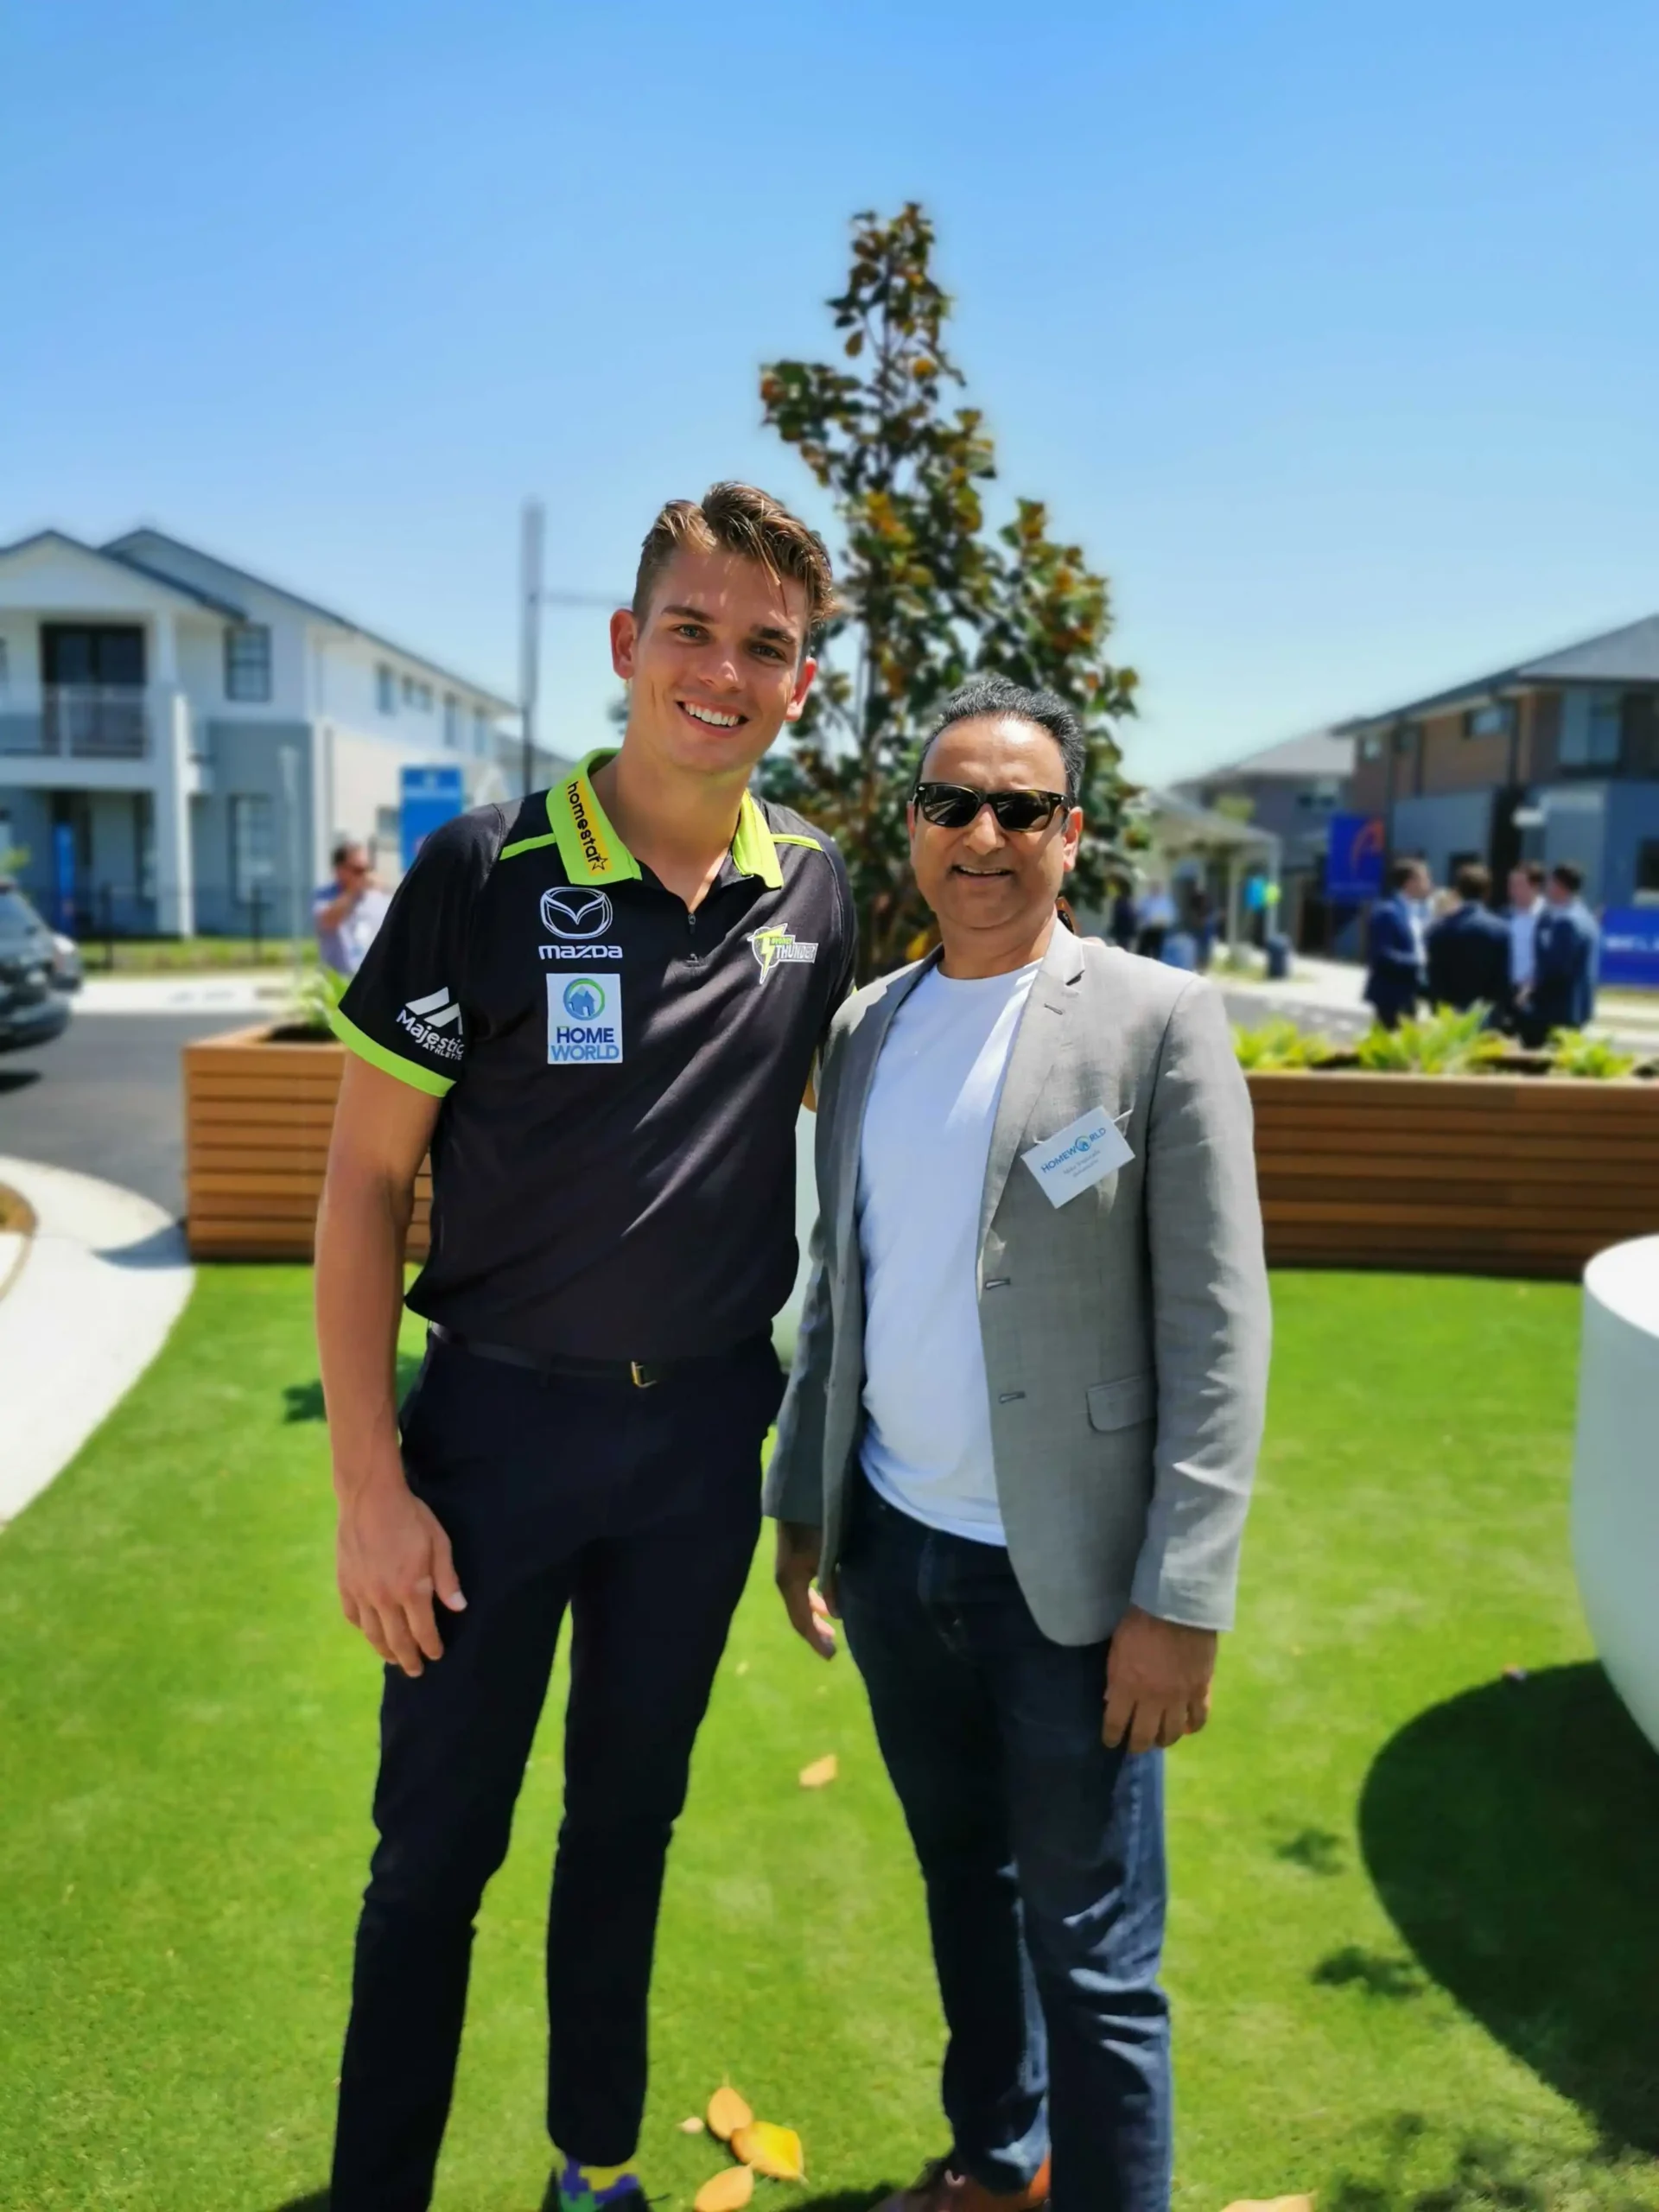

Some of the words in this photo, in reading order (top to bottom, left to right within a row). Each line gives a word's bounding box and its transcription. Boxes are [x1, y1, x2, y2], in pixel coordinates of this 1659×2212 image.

[567, 780, 601, 862] homestar
[776, 944, 817, 960] THUNDER
[395, 1008, 465, 1054] Majestic
[556, 1027, 614, 1044] HOME
[551, 1045, 620, 1061] WORLD
